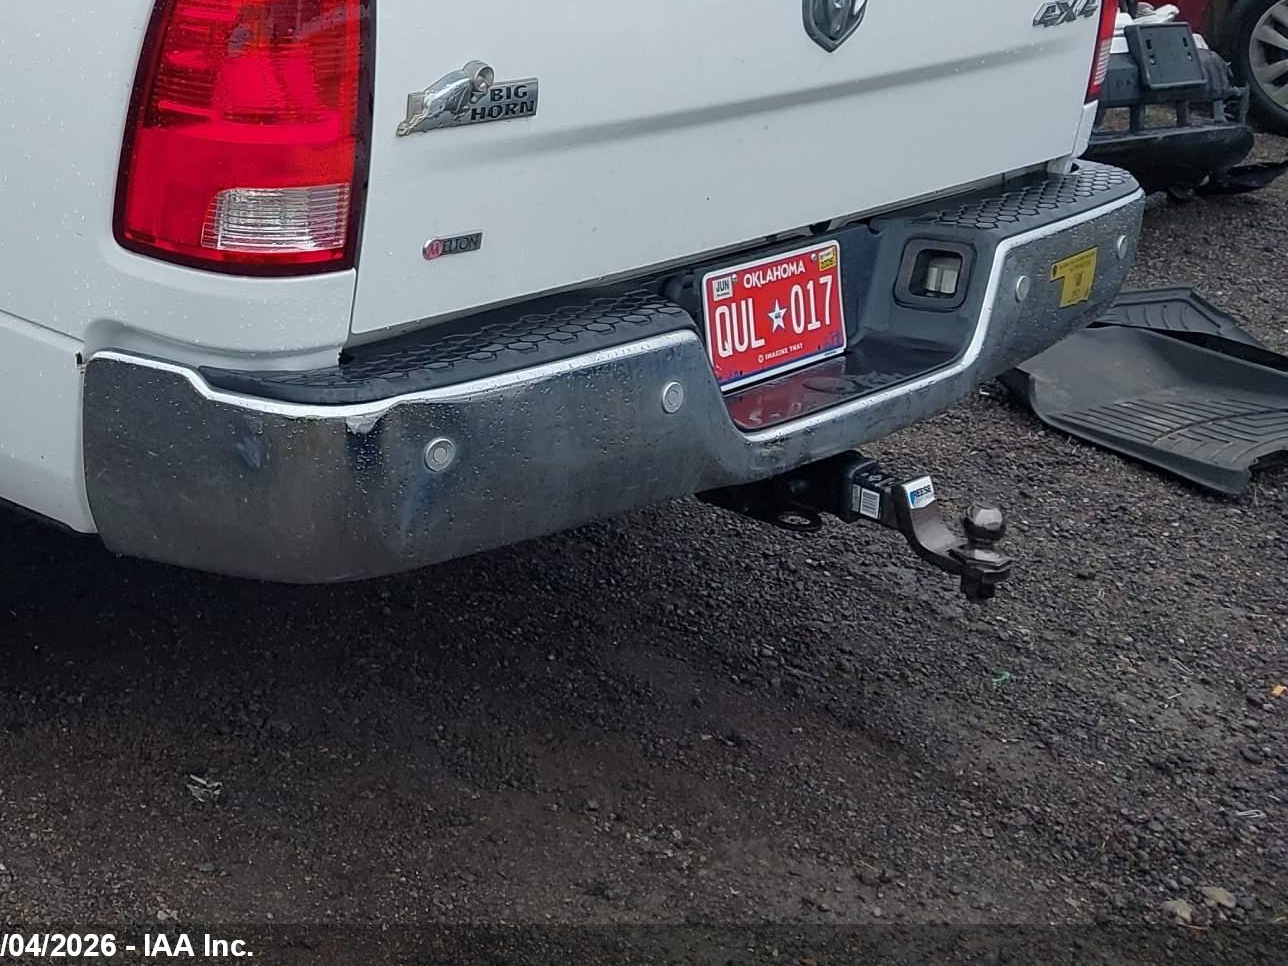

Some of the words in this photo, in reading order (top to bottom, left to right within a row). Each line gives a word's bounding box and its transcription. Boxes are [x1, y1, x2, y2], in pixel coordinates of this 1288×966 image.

[489, 84, 528, 102] BIG
[470, 100, 535, 121] HORN
[743, 260, 805, 289] OKLAHOMA
[715, 279, 730, 293] JUN
[714, 297, 765, 358] QUL
[790, 274, 833, 334] 017
